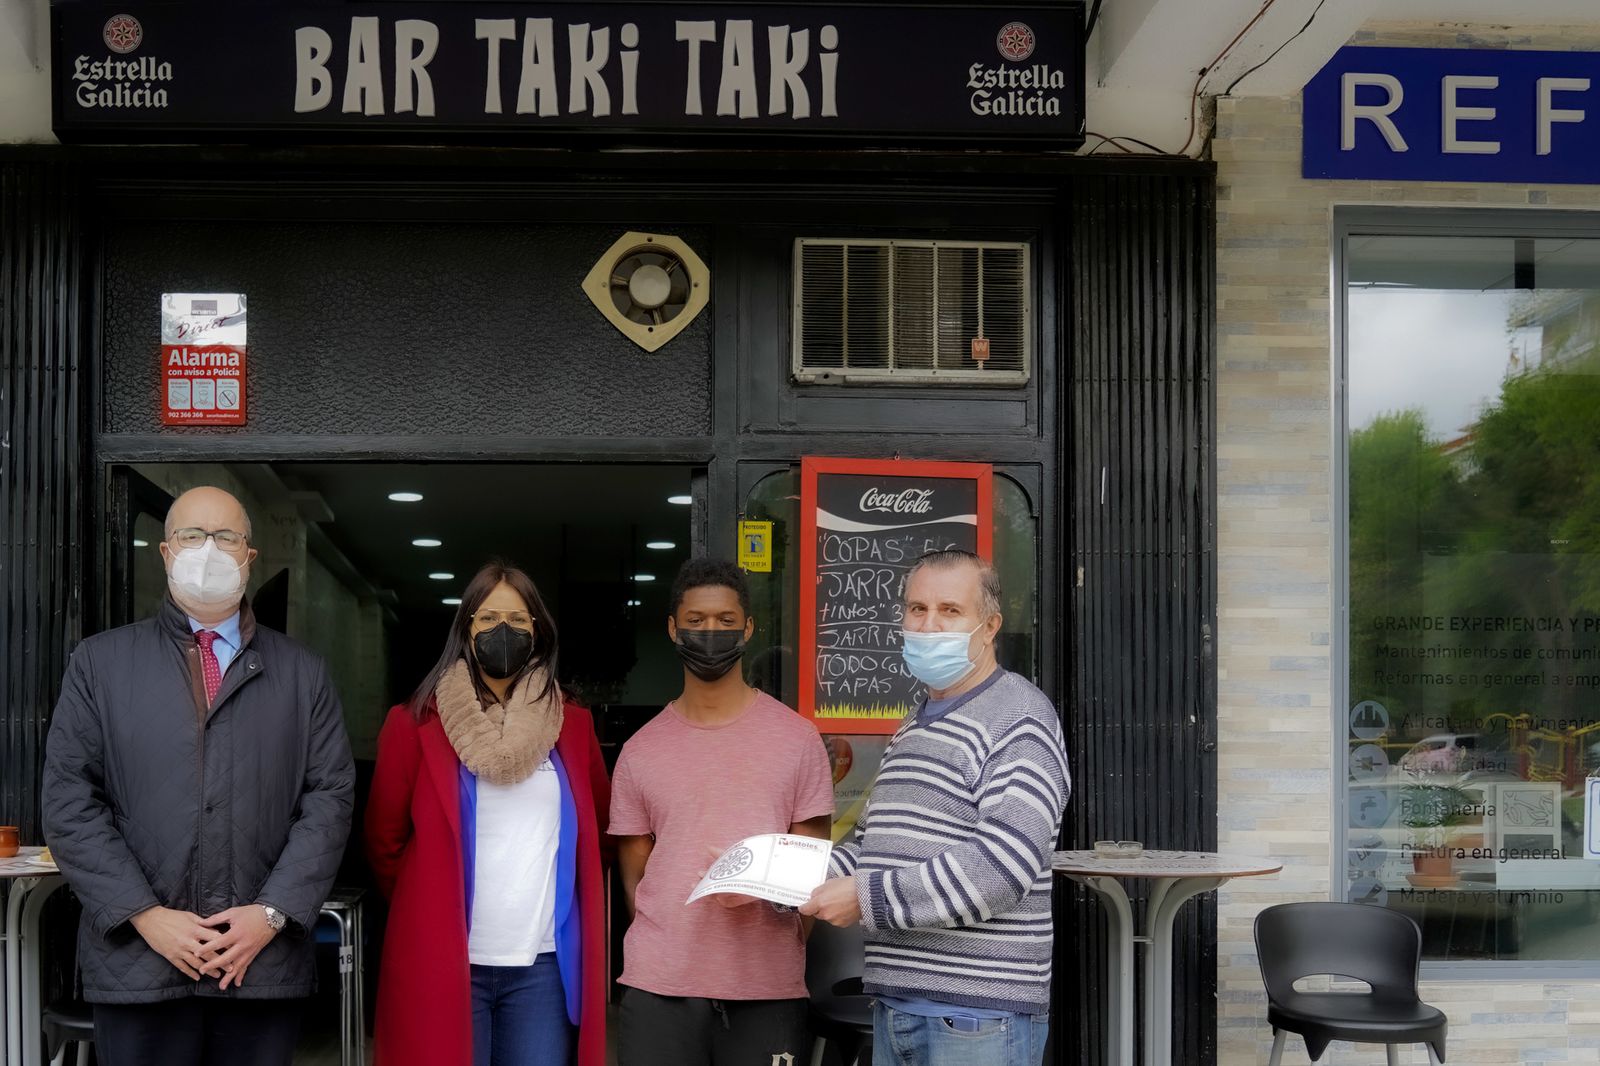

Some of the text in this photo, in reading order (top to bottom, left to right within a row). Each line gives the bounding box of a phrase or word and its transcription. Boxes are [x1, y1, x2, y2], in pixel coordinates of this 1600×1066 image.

[72, 54, 173, 81] Estrella
[294, 16, 440, 117] BAR
[966, 62, 1065, 89] Estrella
[76, 81, 169, 108] Galicia
[970, 89, 1061, 116] Galicia
[176, 315, 231, 338] Direct
[168, 348, 240, 366] Alarma
[184, 368, 205, 376] aviso
[213, 368, 240, 376] Policía
[860, 487, 935, 513] Coca-Cola
[1374, 616, 1445, 631] GRANDE
[1450, 616, 1564, 632] EXPERIENCIA
[1569, 617, 1578, 632] Y
[1375, 644, 1508, 659] Mantenimientos
[1513, 645, 1532, 659] de
[1374, 670, 1454, 686] Reformas
[1459, 674, 1478, 685] en
[1483, 671, 1546, 689] general
[1401, 713, 1484, 729] Alicatado
[1491, 717, 1499, 732] y
[1401, 800, 1497, 817] Fontanería
[1401, 843, 1567, 863] Pintura en general
[1400, 887, 1565, 906] Madera y aluminio
